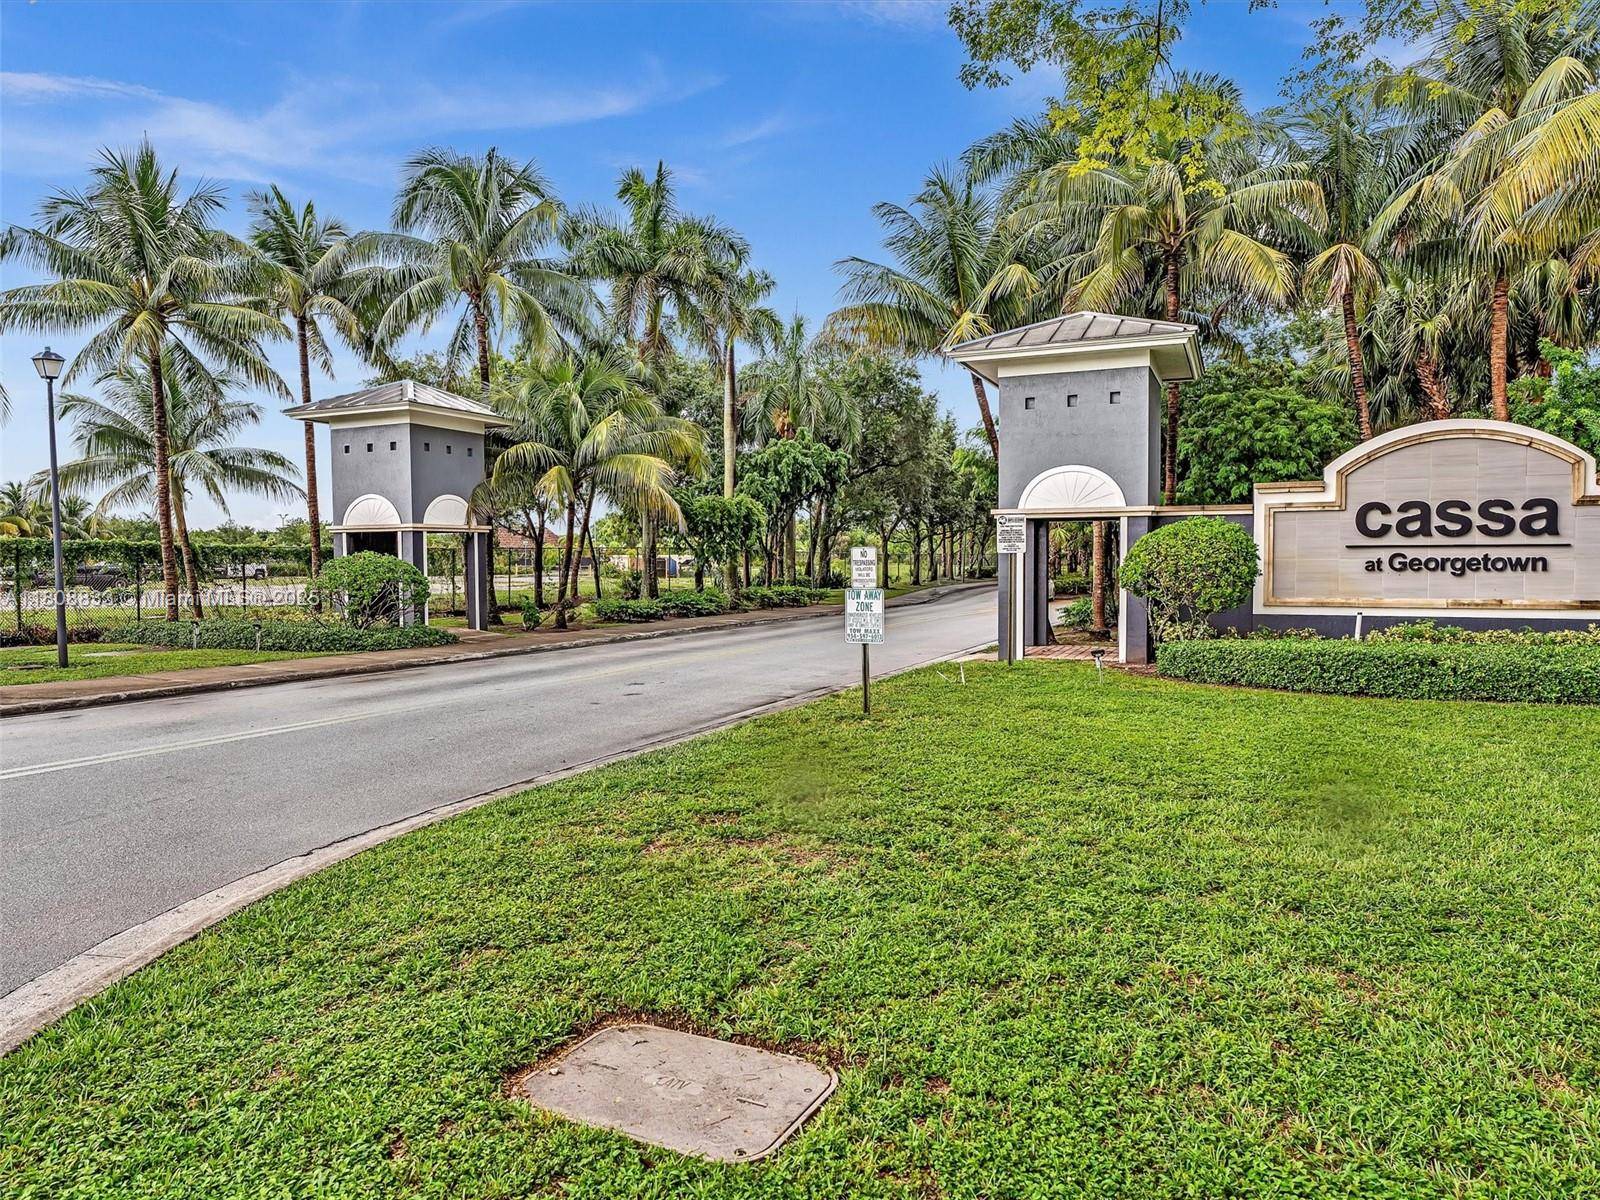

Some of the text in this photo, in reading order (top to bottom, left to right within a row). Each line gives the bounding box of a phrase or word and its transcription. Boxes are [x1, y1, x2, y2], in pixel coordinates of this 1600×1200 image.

[1355, 498, 1560, 539] cassa
[860, 550, 868, 559] NO
[1364, 552, 1548, 577] at Georgetown
[848, 590, 882, 600] TOW AWAY
[856, 601, 874, 612] ZONE
